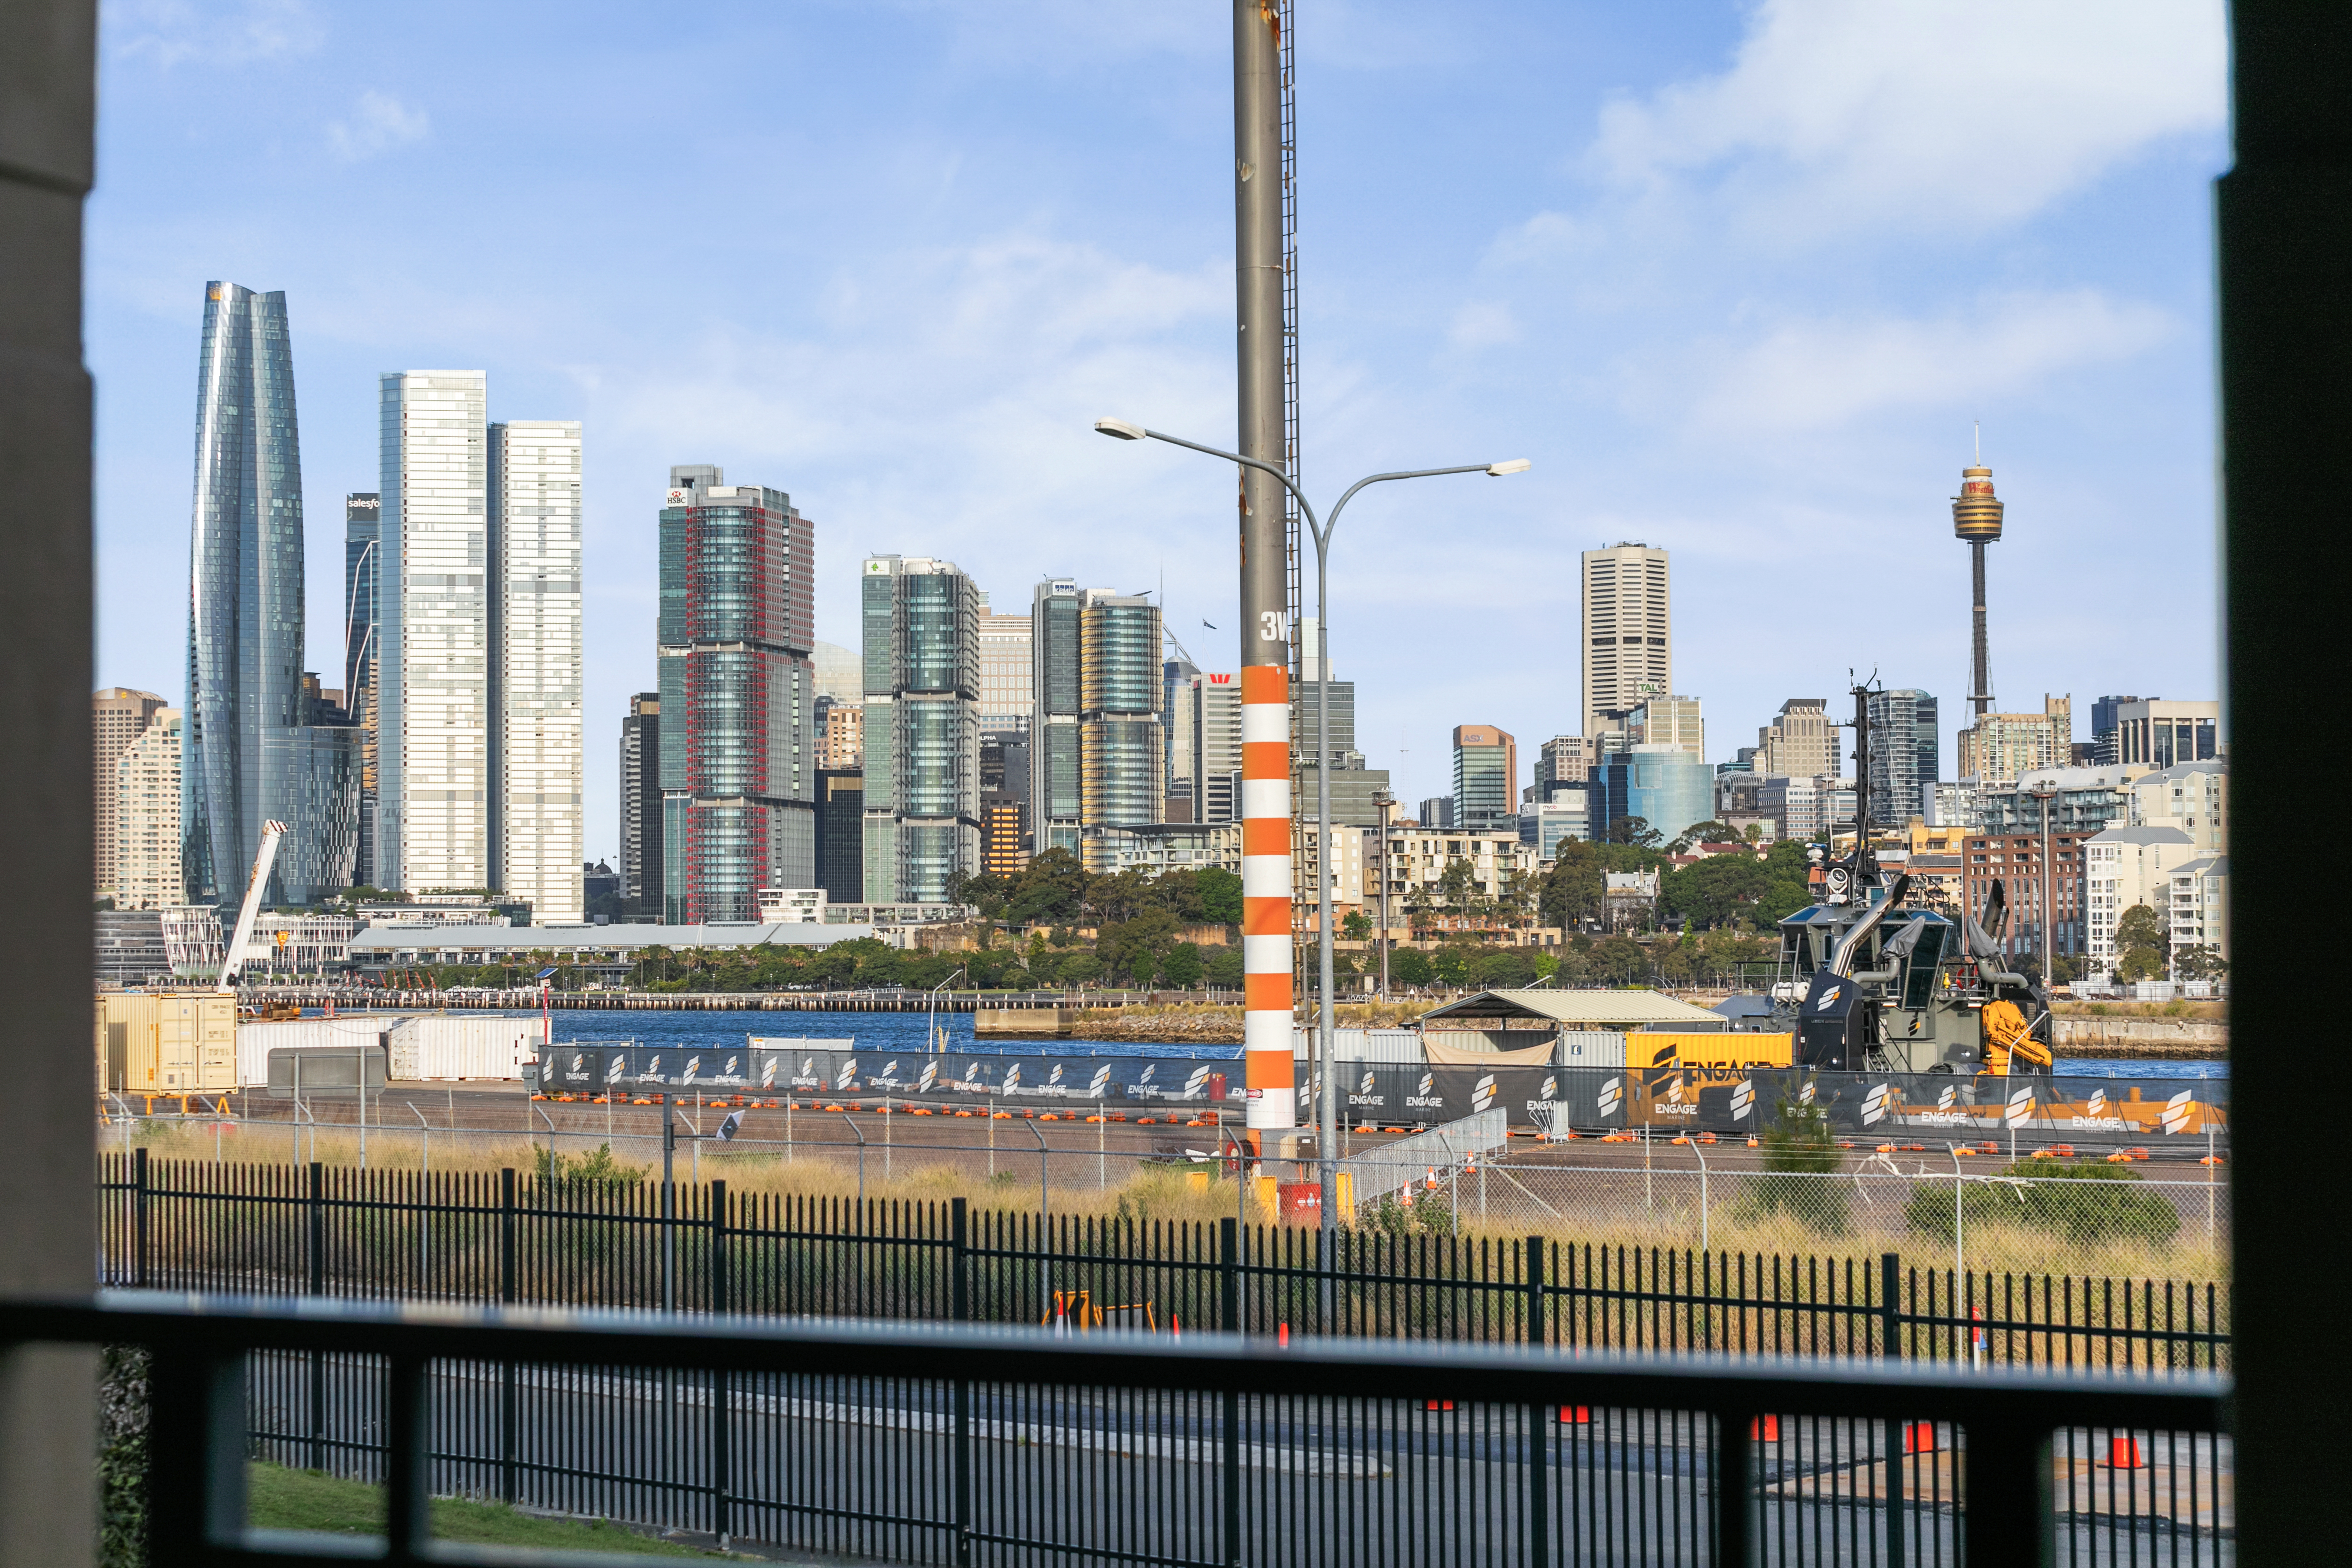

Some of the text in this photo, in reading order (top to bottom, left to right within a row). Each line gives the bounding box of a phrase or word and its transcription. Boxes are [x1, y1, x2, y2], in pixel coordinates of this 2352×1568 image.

[348, 498, 380, 510] salesfo
[640, 1073, 665, 1082] ENGAGE
[791, 1077, 818, 1085] ENGAGE
[870, 1078, 899, 1086] ENGAGE
[953, 1082, 982, 1091] ENGAGE
[1038, 1085, 1067, 1093] ENGAGE
[1127, 1085, 1159, 1093] ENGAGE
[1349, 1094, 1384, 1105] ENGAGE
[1406, 1096, 1442, 1107] ENGAGE
[1526, 1100, 1554, 1110] ENGA
[1655, 1103, 1697, 1114] ENGAGE
[1921, 1111, 1967, 1123] ENGAGE
[2072, 1115, 2121, 1128] ENGAGE
